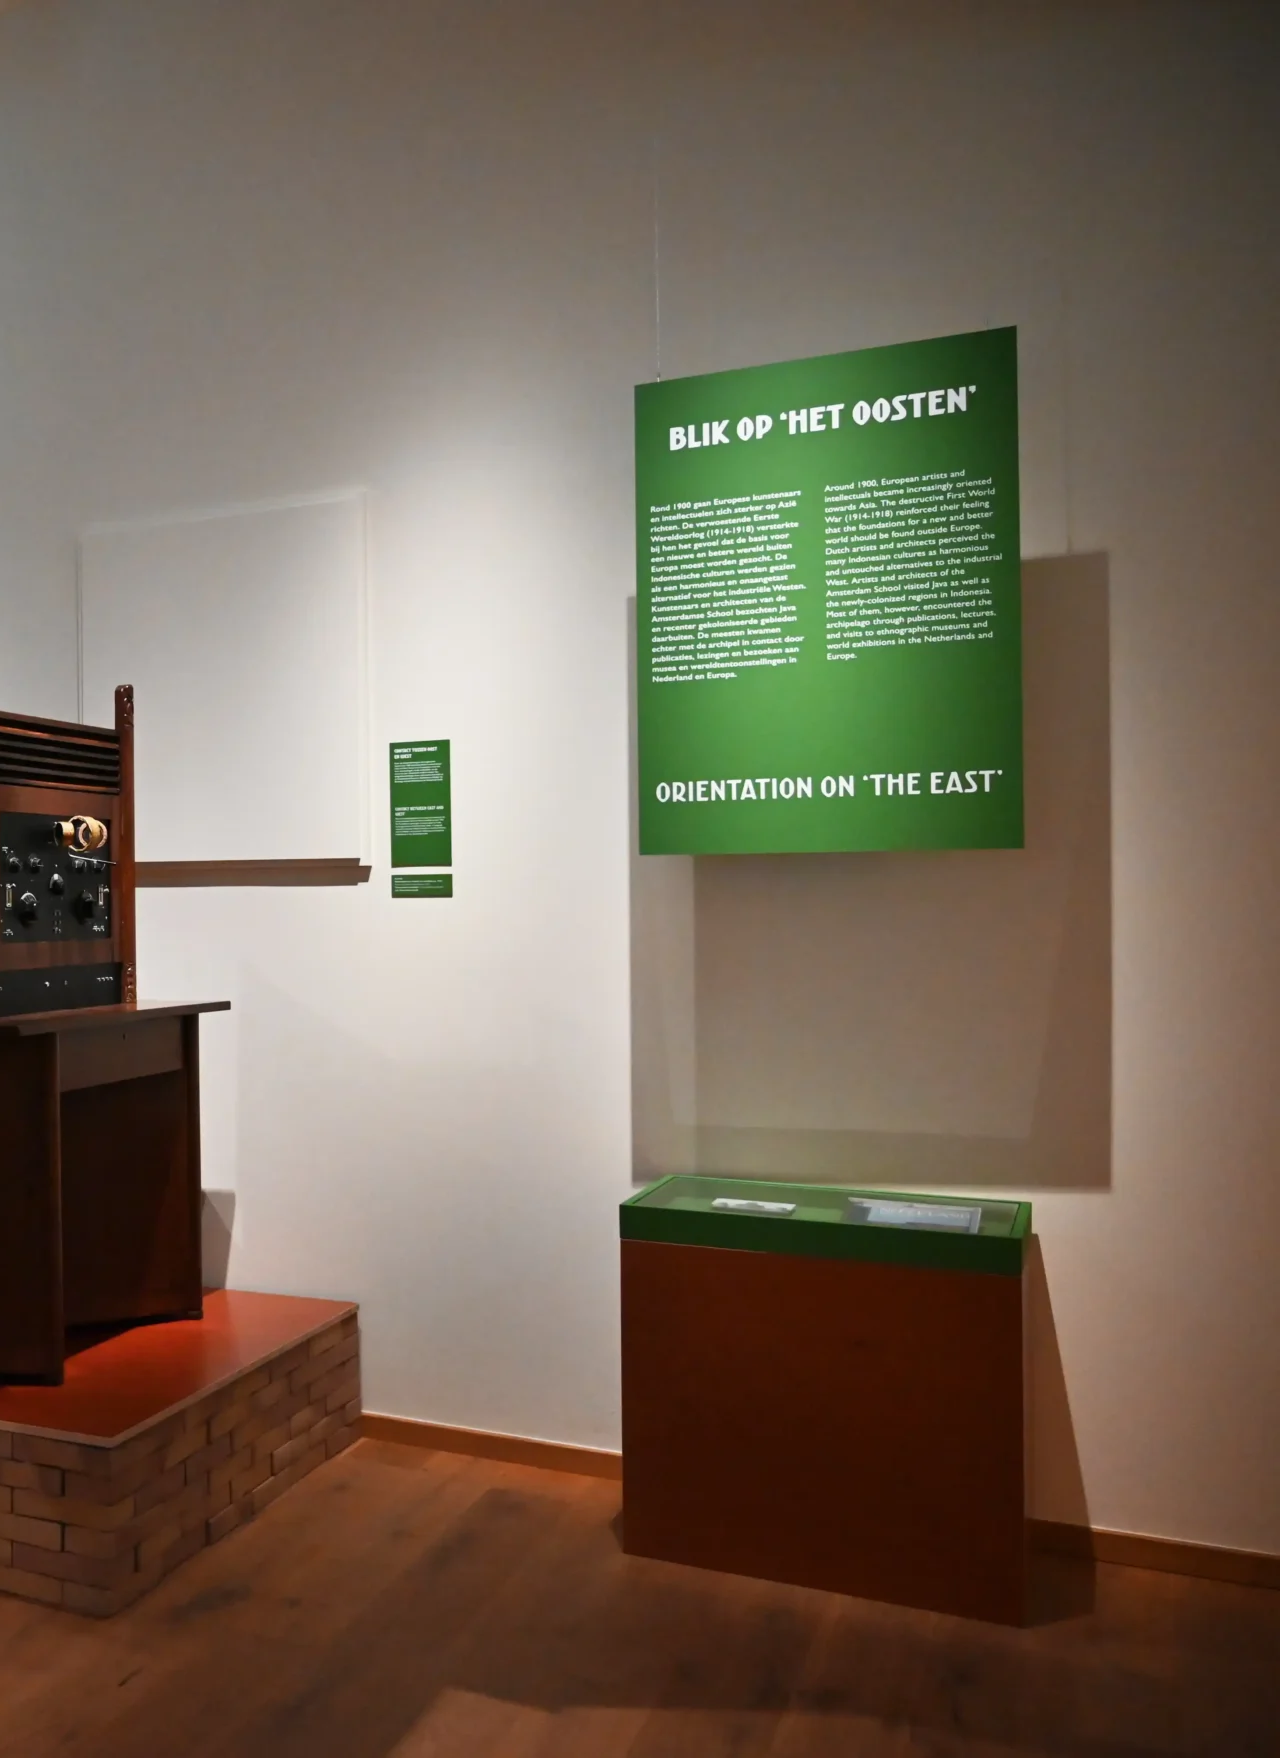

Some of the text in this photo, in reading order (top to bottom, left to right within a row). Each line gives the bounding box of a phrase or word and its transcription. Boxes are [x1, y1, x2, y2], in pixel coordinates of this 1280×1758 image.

[670, 420, 730, 452] BLIK
[736, 414, 774, 442] OP
[824, 482, 854, 492] Around
[881, 476, 919, 485] European
[921, 472, 947, 480] artists
[949, 469, 965, 477] and
[873, 489, 904, 497] became
[955, 477, 992, 487] oriented
[650, 504, 670, 513] Rond
[673, 501, 691, 510] 1900
[693, 500, 711, 509] gaan
[713, 496, 750, 505] Europese
[824, 503, 856, 513] towards
[967, 487, 995, 496] World
[716, 507, 732, 515] zich
[734, 505, 763, 513] sterker
[753, 513, 779, 521] Eerste
[824, 515, 842, 523] War
[896, 505, 937, 515] reinforced
[940, 503, 960, 511] their
[962, 500, 989, 508] feeling
[756, 521, 799, 530] versterkte
[824, 526, 840, 534] that
[949, 512, 964, 521] and
[966, 511, 993, 519] better
[650, 545, 660, 553] bij
[693, 539, 718, 549] gevoel
[748, 534, 767, 542] basis
[825, 536, 848, 544] world
[850, 533, 876, 542] should
[891, 528, 914, 537] found
[916, 526, 947, 535] outside
[825, 546, 850, 555] Dutch
[896, 539, 936, 548] architects
[938, 533, 978, 545] perceived
[736, 545, 764, 553] wereld
[848, 554, 891, 563] Indonesian
[893, 551, 925, 559] cultures
[939, 545, 988, 554] harmonious
[825, 568, 840, 576] and
[841, 564, 884, 574] untouched
[963, 552, 1002, 563] industrial
[897, 571, 937, 580] architects
[939, 568, 948, 576] of
[825, 587, 871, 596] Amsterdam
[874, 584, 901, 592] School
[903, 581, 929, 589] visited
[931, 580, 947, 589] Java
[908, 593, 937, 601] regions
[826, 610, 846, 618] Most
[872, 616, 904, 624] through
[826, 631, 840, 639] and
[931, 623, 969, 631] museums
[972, 620, 987, 628] and
[826, 641, 849, 649] world
[908, 636, 921, 644] the
[977, 630, 993, 638] and
[656, 776, 812, 802] ORIENTATION
[820, 774, 854, 798] ON
